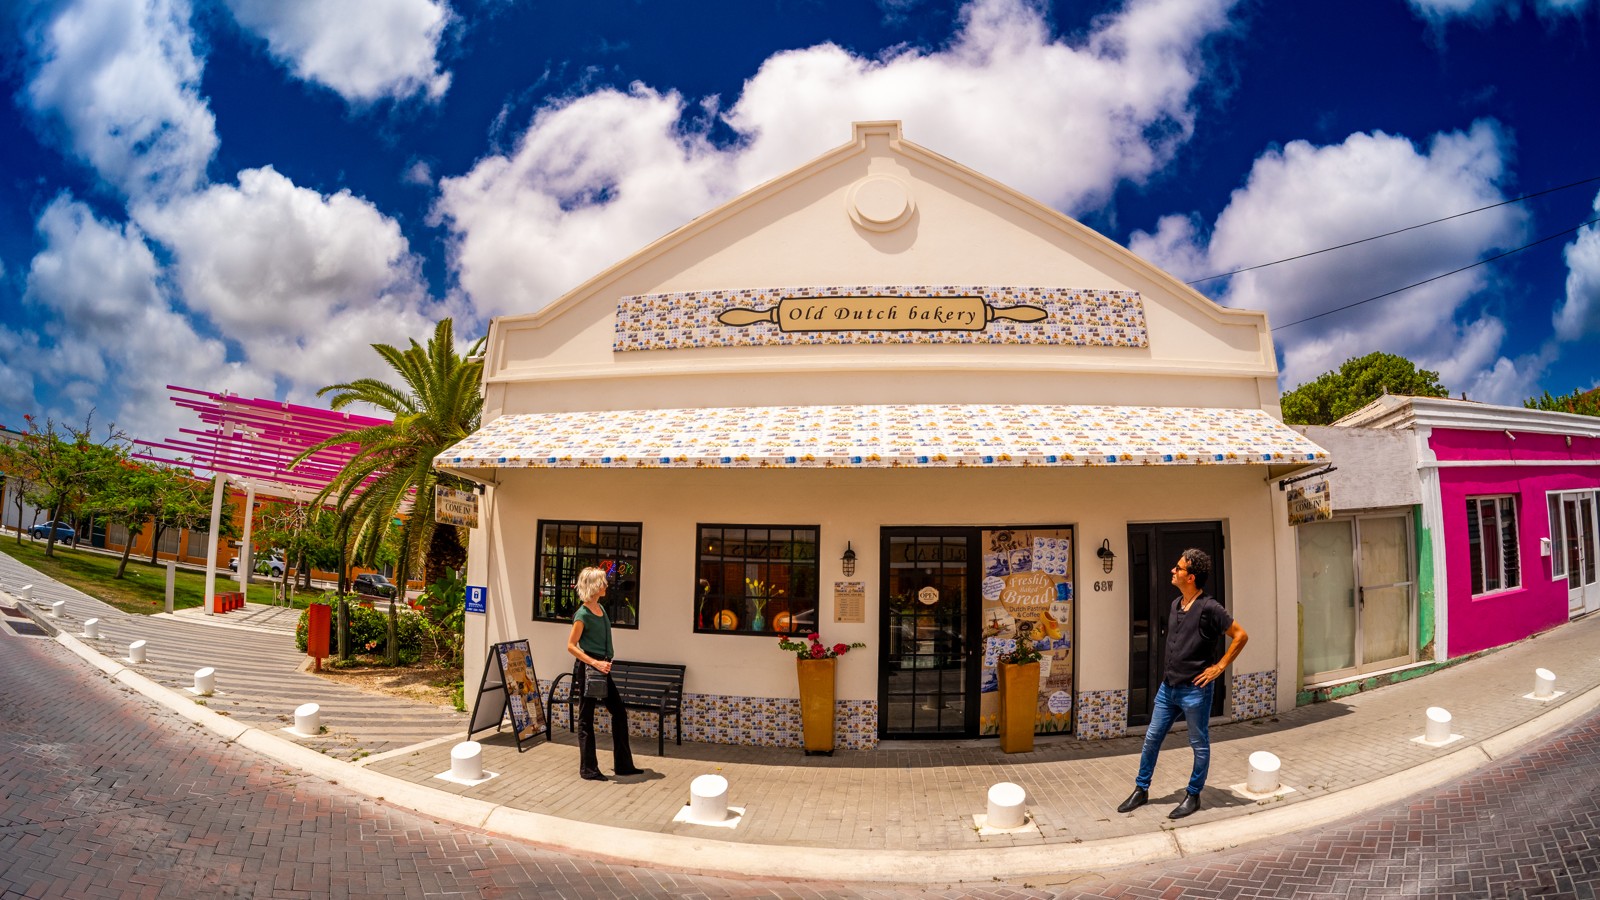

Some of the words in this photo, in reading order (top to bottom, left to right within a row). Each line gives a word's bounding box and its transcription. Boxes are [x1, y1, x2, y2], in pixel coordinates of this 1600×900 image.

[789, 306, 827, 320] Old
[834, 306, 897, 320] Dutch
[908, 305, 976, 325] bakery
[445, 503, 463, 514] COME
[1296, 501, 1313, 512] COME
[1009, 574, 1050, 587] Freshly
[1094, 581, 1113, 592] 68W
[1003, 586, 1055, 605] Bread!
[1009, 605, 1027, 613] Dutch
